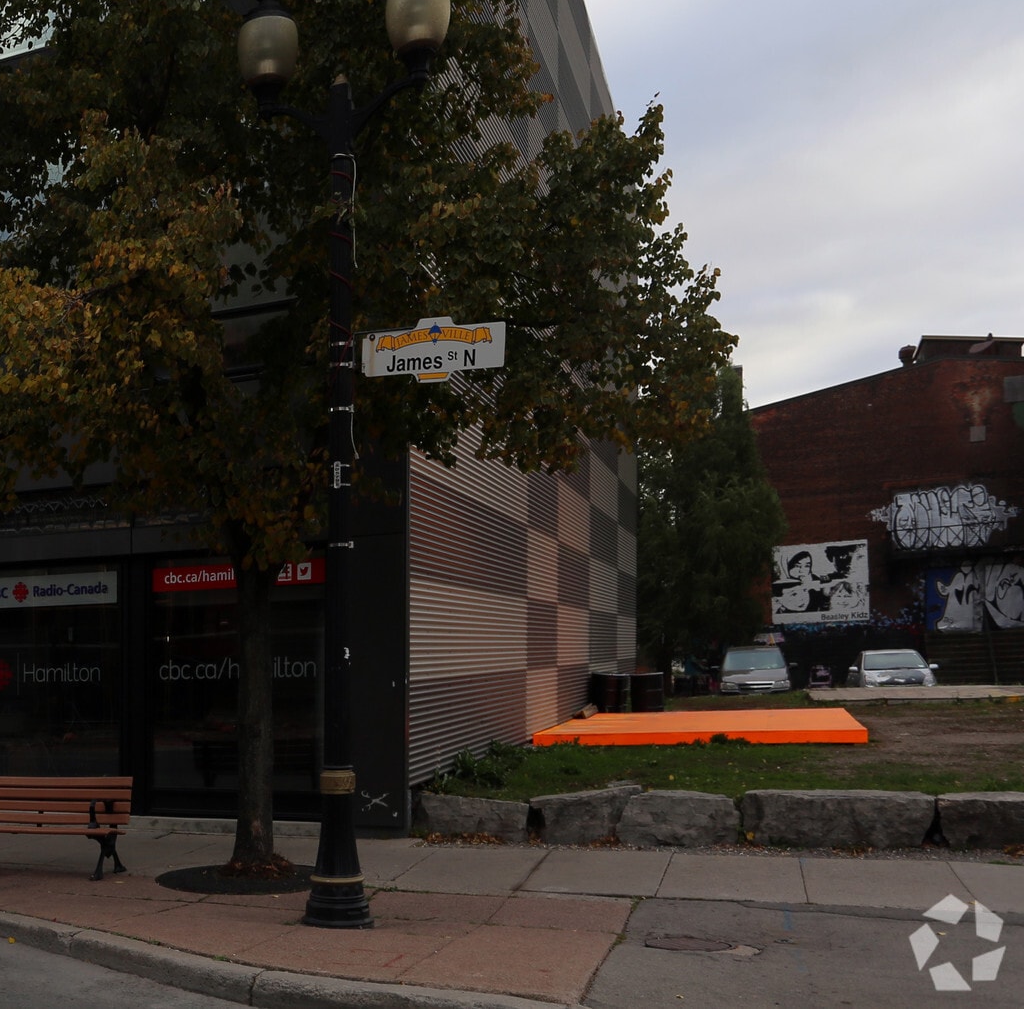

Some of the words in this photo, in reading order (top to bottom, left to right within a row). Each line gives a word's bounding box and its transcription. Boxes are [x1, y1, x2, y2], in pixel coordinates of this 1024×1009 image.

[396, 332, 429, 346] JAMES
[443, 329, 471, 340] VILLE
[387, 355, 443, 372] James
[447, 351, 458, 360] St
[464, 349, 476, 366] N
[164, 568, 235, 584] cbc.ca/hamil
[33, 582, 108, 597] Radio-Canada
[851, 611, 869, 619] Kidz
[23, 662, 102, 683] Hamilton
[158, 657, 317, 680] cbc.ca/hilton
